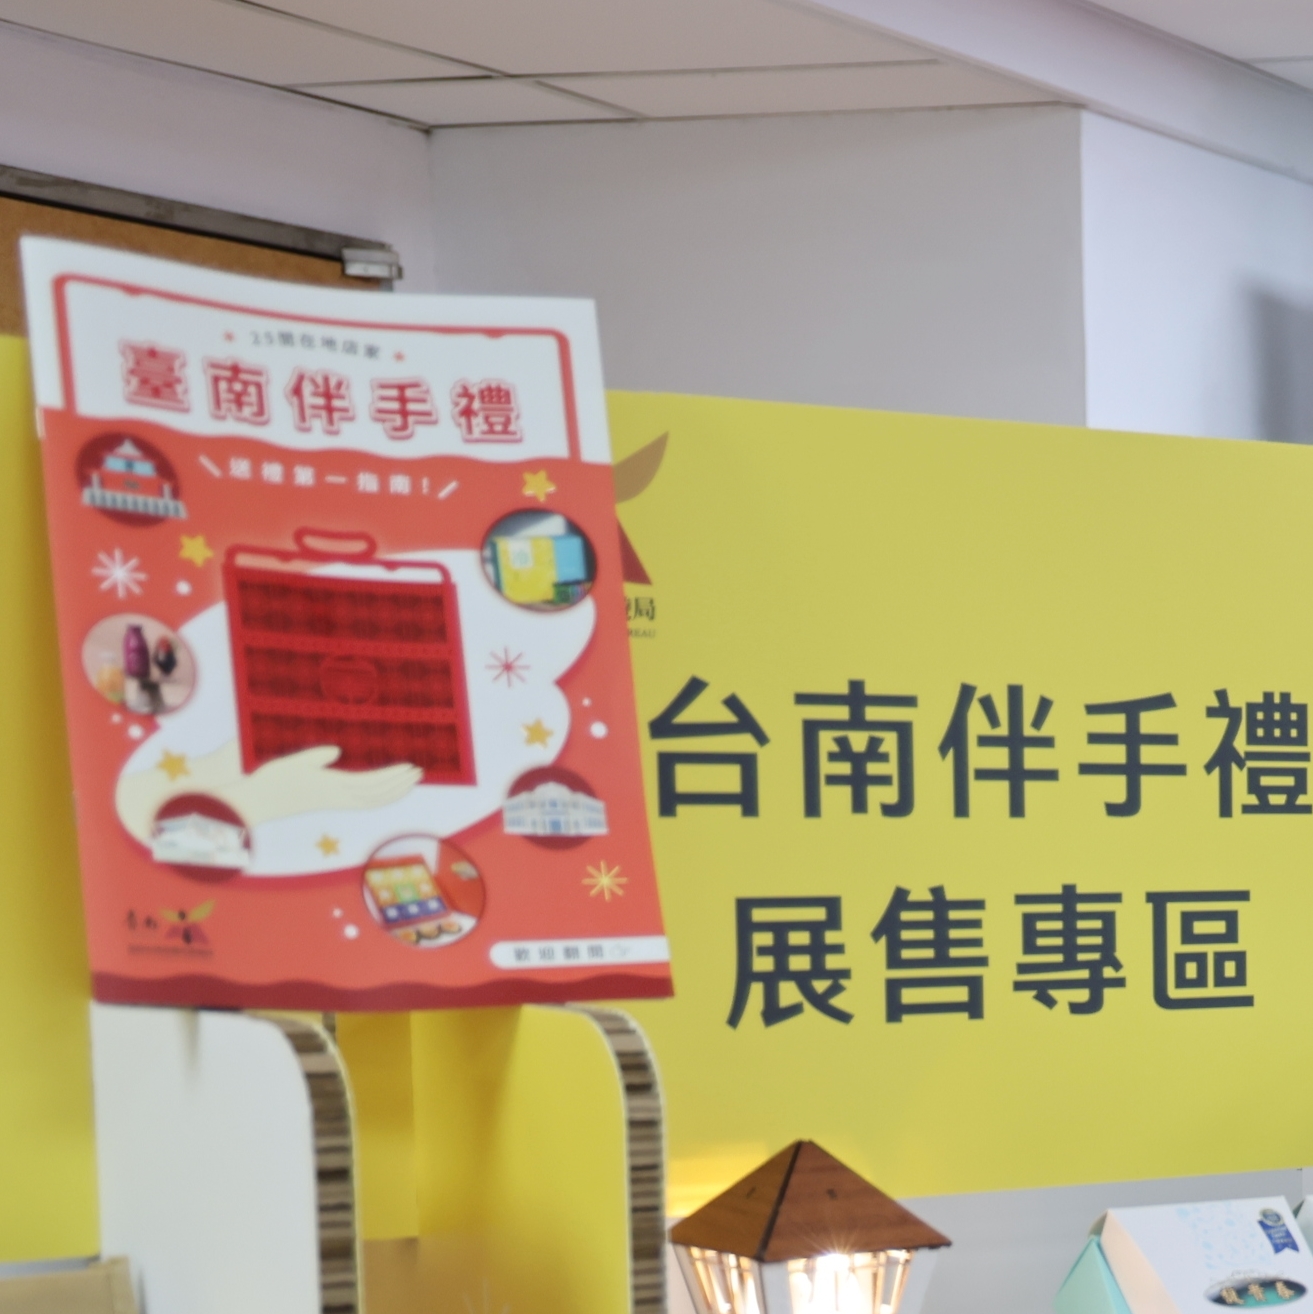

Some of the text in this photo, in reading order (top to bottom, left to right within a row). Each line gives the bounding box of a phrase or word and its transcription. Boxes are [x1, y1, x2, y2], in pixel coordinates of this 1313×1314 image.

[119, 341, 523, 443] 臺南伴手禮
[647, 674, 1313, 819] 台南伴手禮
[725, 883, 1255, 1030] 展售專區
